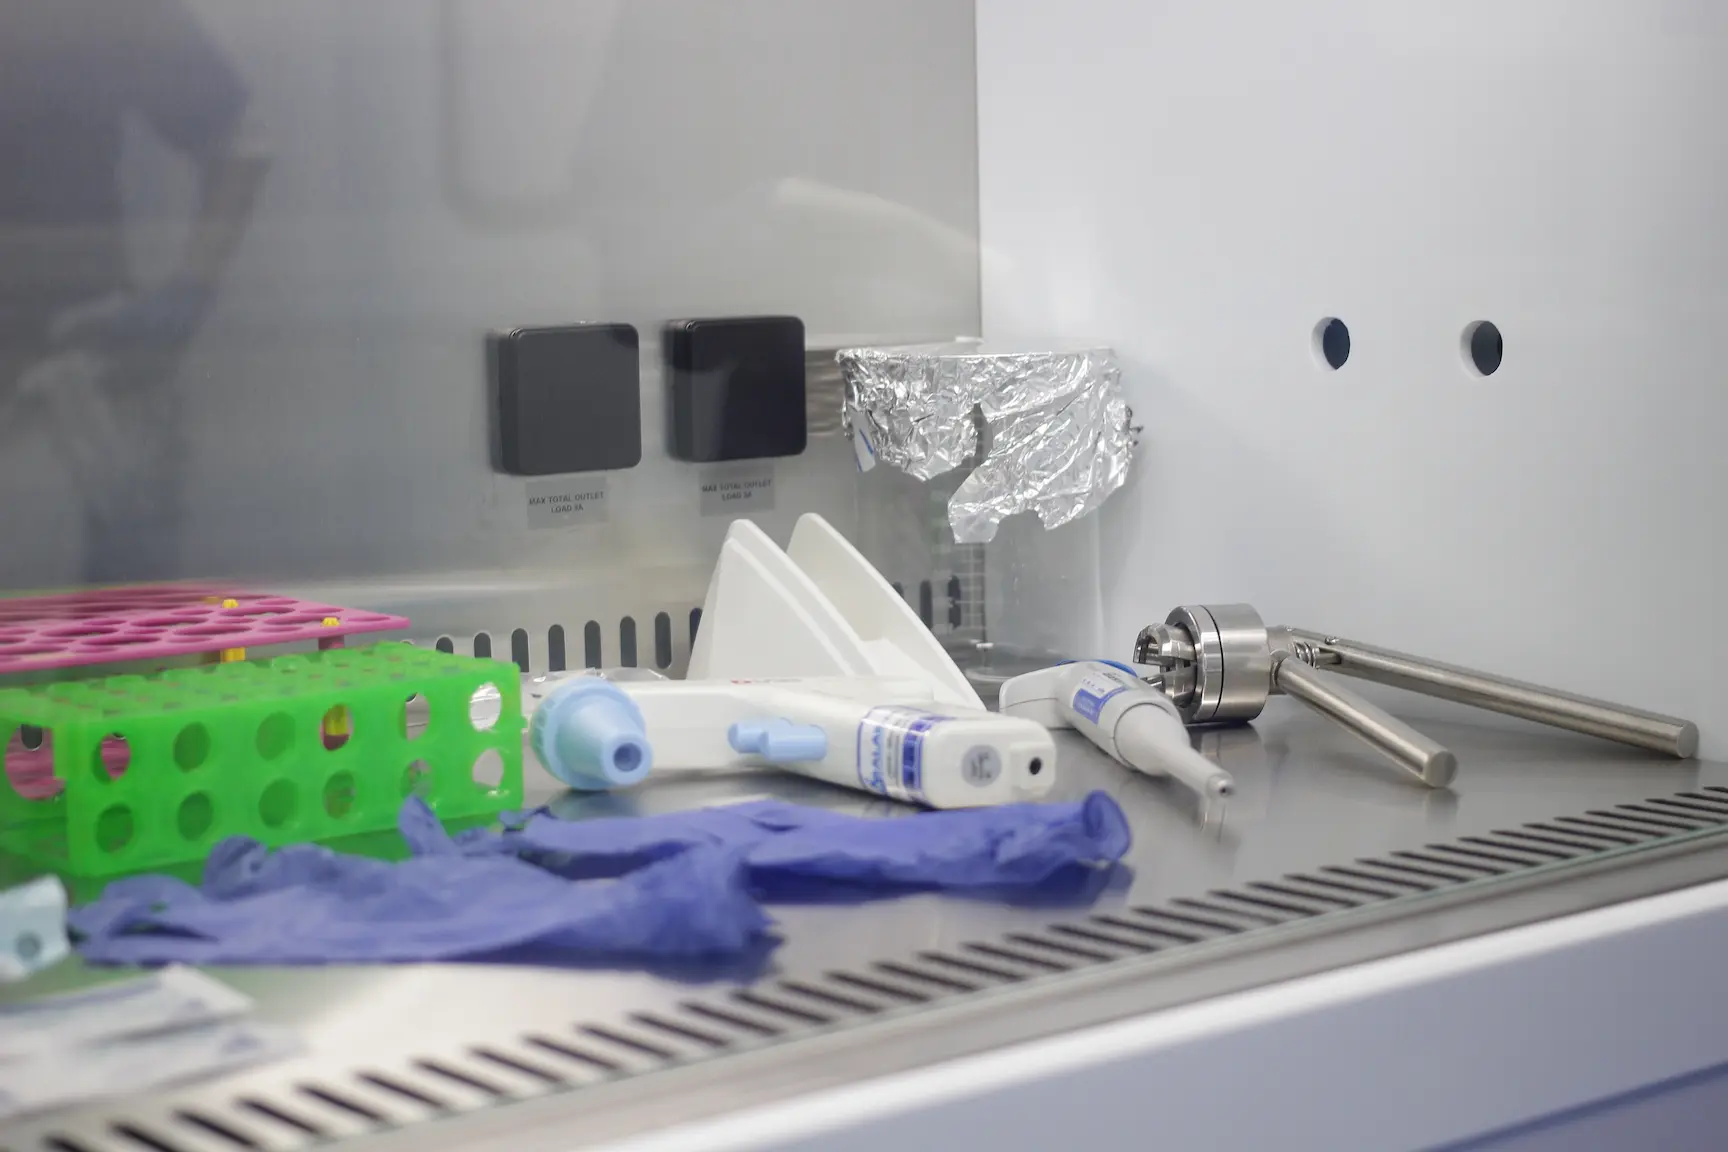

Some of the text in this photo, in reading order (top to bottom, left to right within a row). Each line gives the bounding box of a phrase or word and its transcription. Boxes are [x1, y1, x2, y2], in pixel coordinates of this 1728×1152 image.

[701, 478, 771, 493] MAX TOTAL OUTLET
[529, 490, 604, 505] MAX TOTAL OUTLET
[721, 491, 742, 502] LOAD
[551, 504, 572, 514] LOAD
